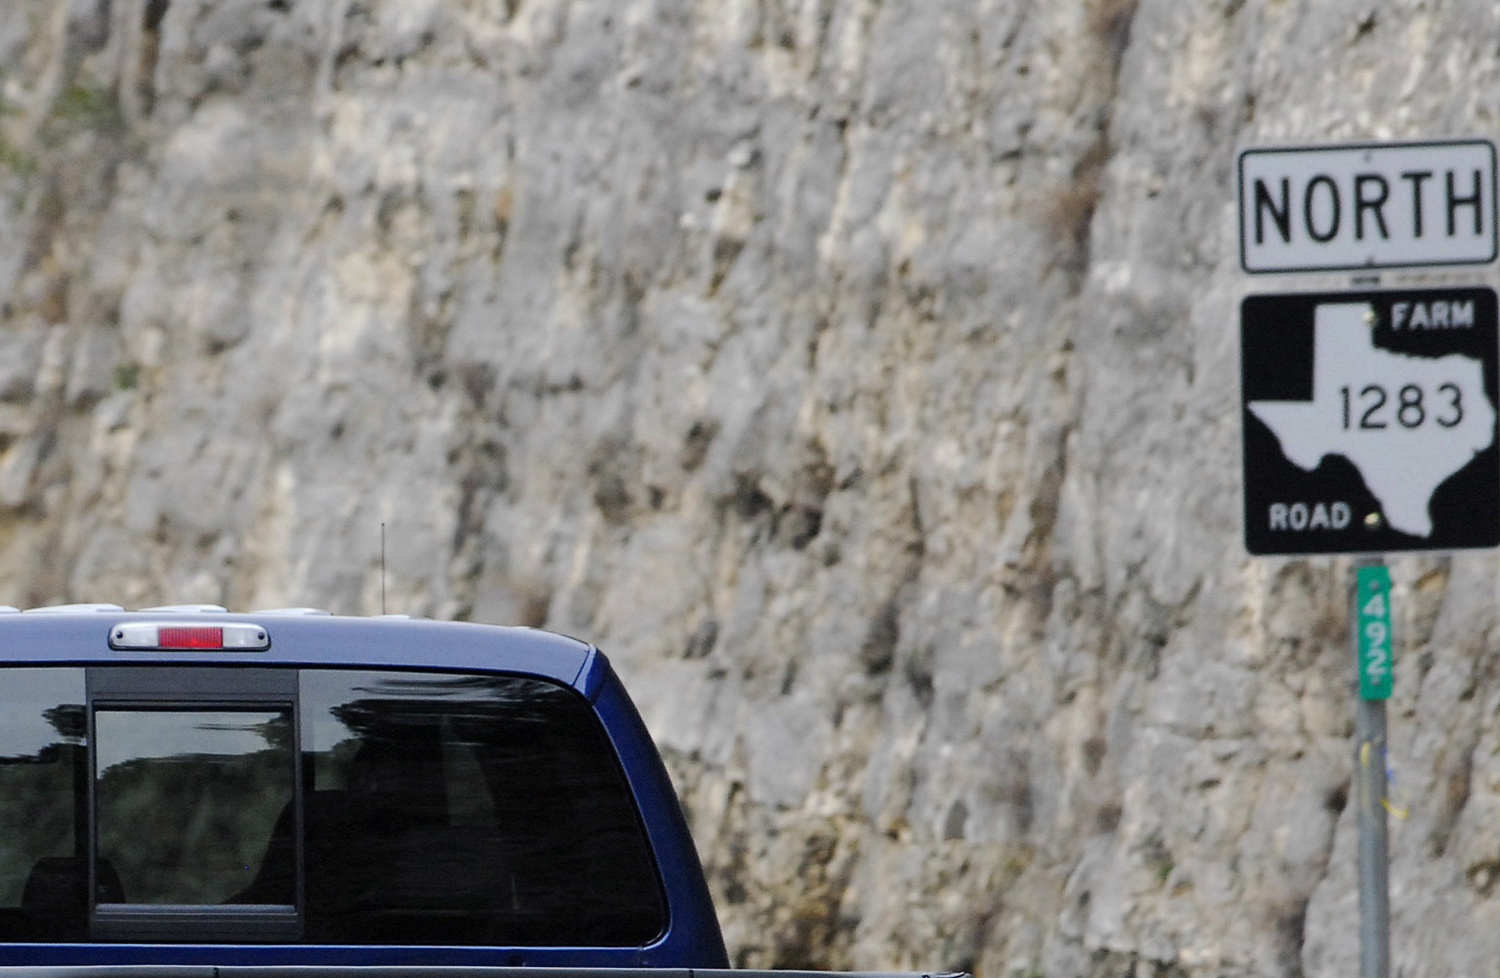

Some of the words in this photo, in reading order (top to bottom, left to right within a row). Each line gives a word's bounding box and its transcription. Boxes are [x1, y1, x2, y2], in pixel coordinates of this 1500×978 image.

[1254, 169, 1482, 246] NORTH
[1391, 302, 1474, 331] FARM
[1339, 383, 1464, 430] 1283
[1269, 503, 1351, 531] ROAD
[1363, 593, 1387, 675] 492
